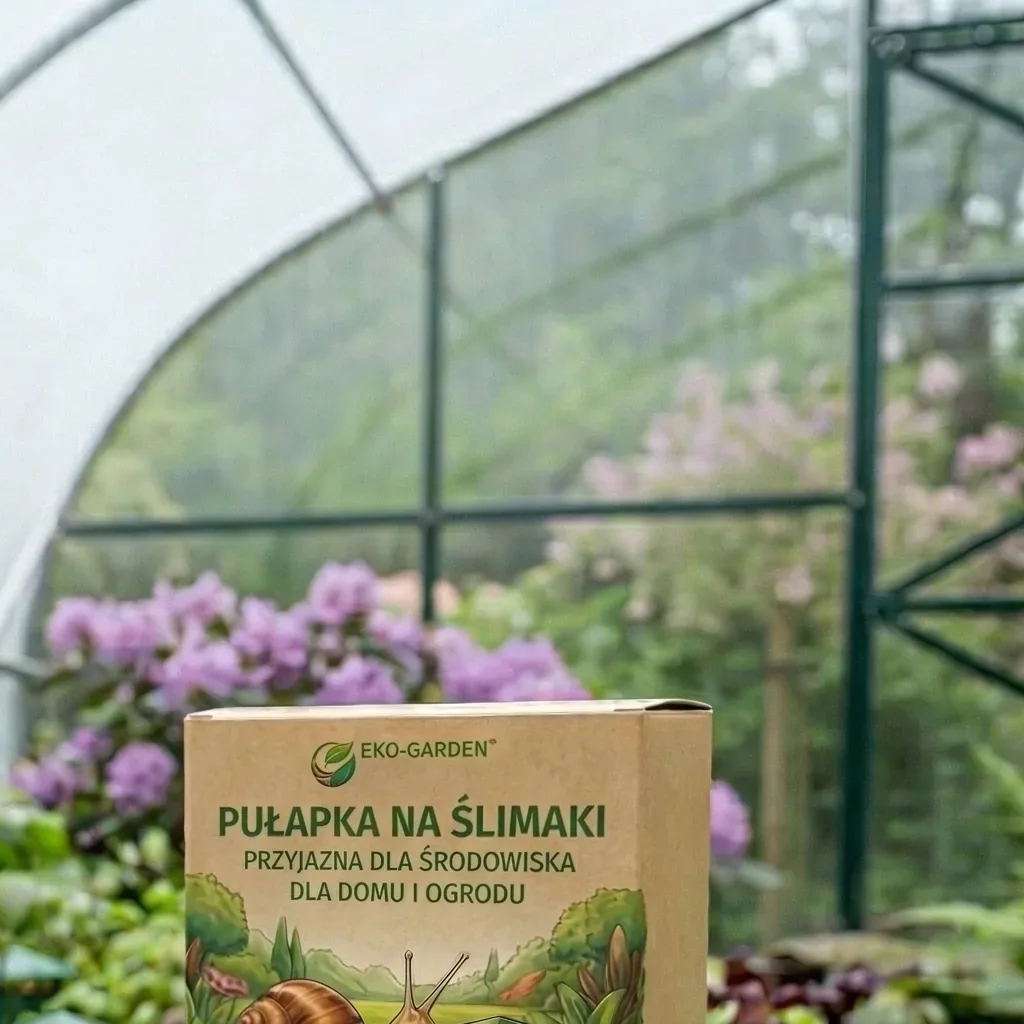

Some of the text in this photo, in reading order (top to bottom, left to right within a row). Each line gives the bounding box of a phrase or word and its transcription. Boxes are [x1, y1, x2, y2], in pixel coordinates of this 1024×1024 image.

[219, 793, 606, 839] PUŁAPKA NA ŚLIMAKI
[244, 844, 577, 874] PRZYJAZNA DLA ŚRODOWISKA
[290, 881, 525, 905] DLA DOMU I OGRODU
